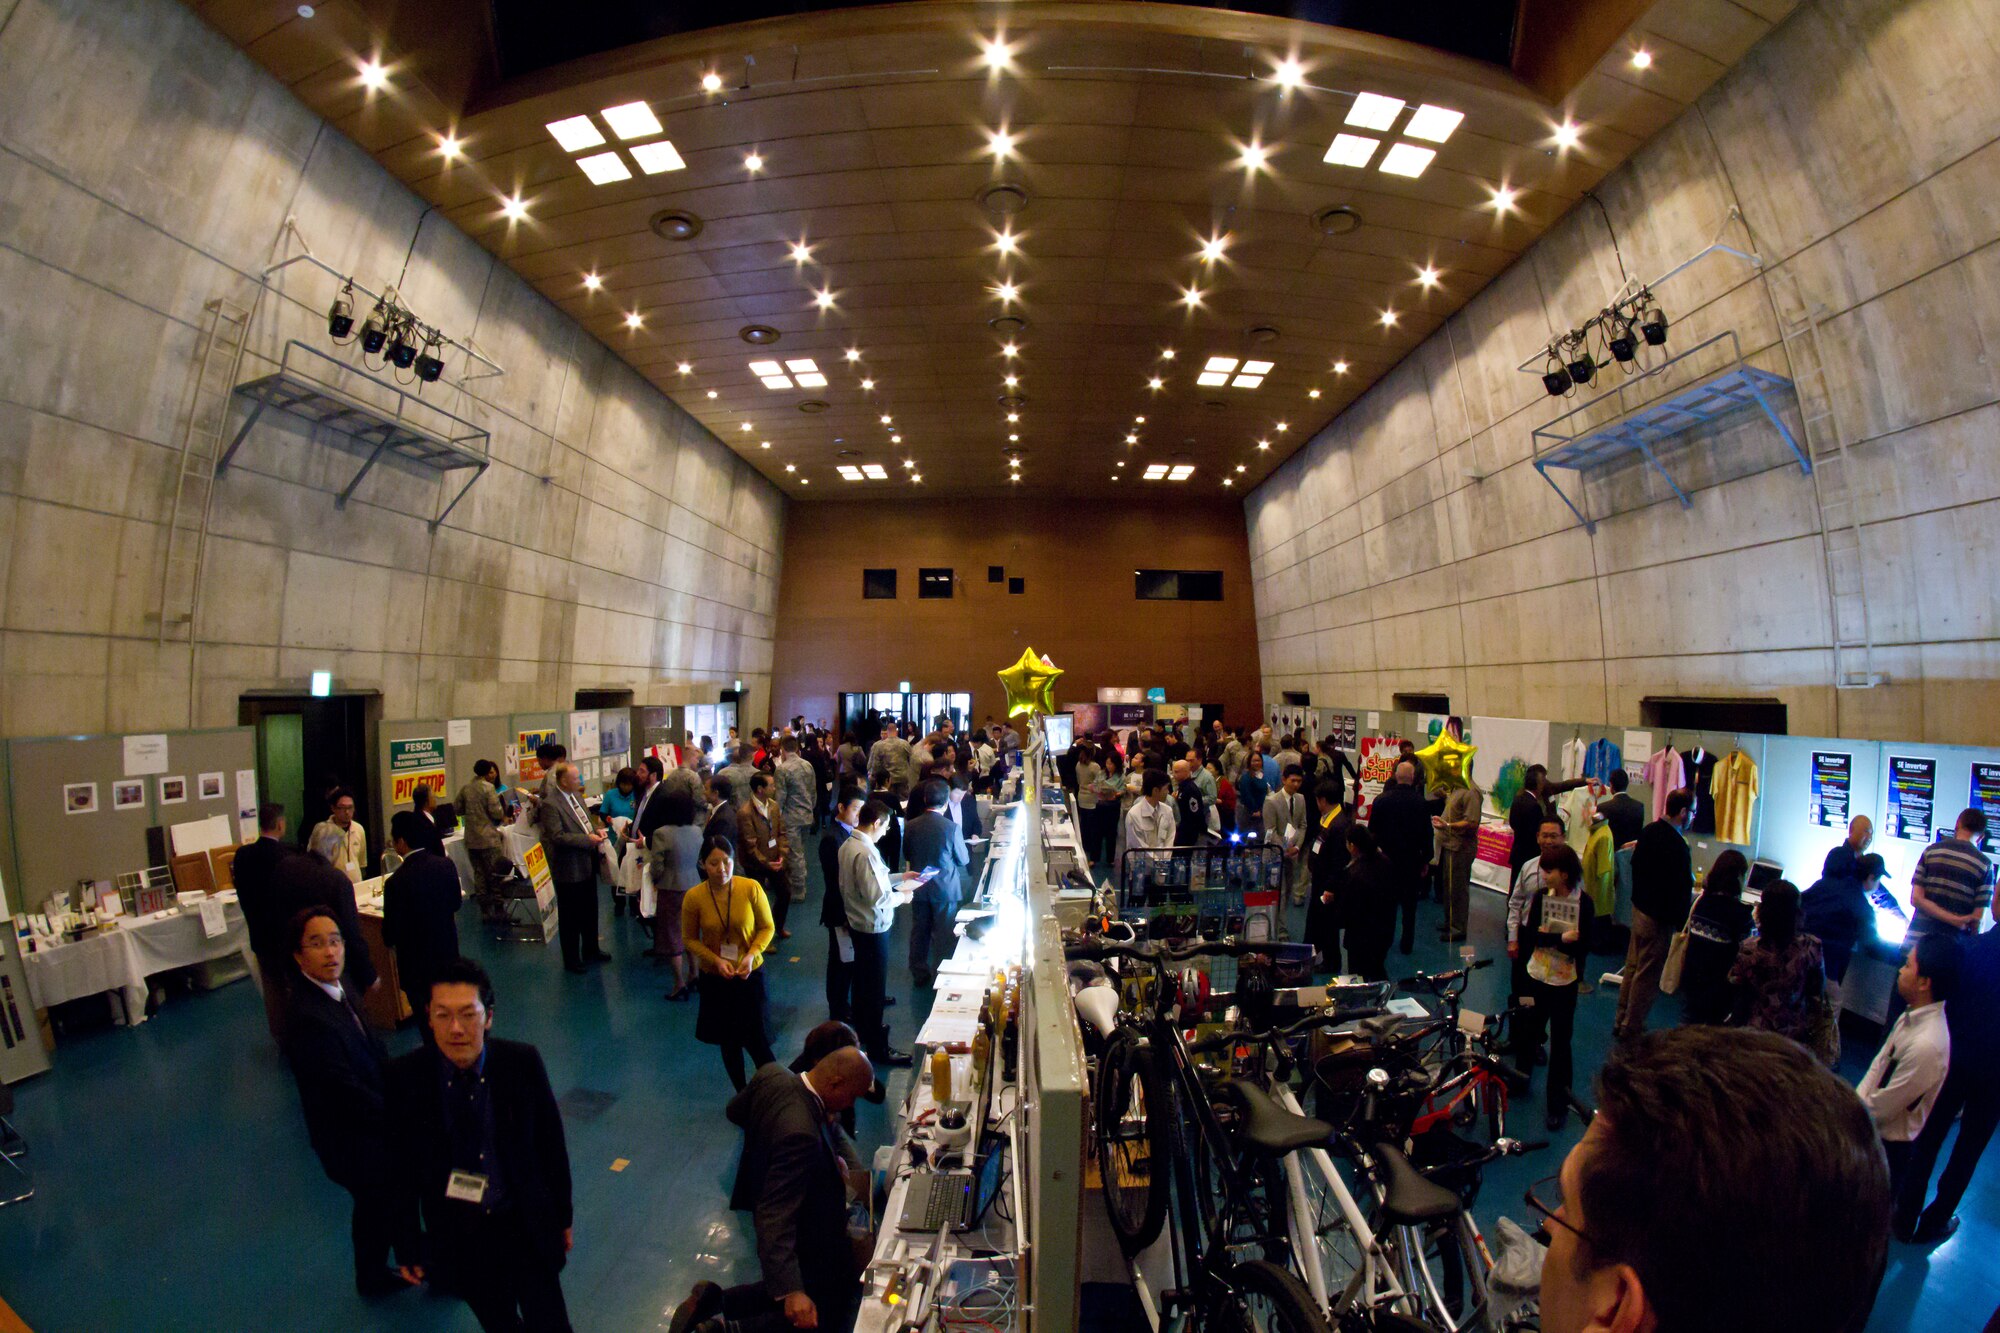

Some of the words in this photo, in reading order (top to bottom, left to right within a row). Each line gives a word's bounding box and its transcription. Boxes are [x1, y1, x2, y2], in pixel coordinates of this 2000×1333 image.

[405, 742, 432, 752] FESCO
[526, 732, 556, 752] WD-40
[397, 751, 439, 760] ENVIRONMENTAL
[1367, 753, 1401, 769] stan
[1904, 762, 1928, 770] inverter
[1980, 768, 1988, 776] SE
[395, 778, 415, 800] PIT
[141, 889, 164, 913] EXIT
